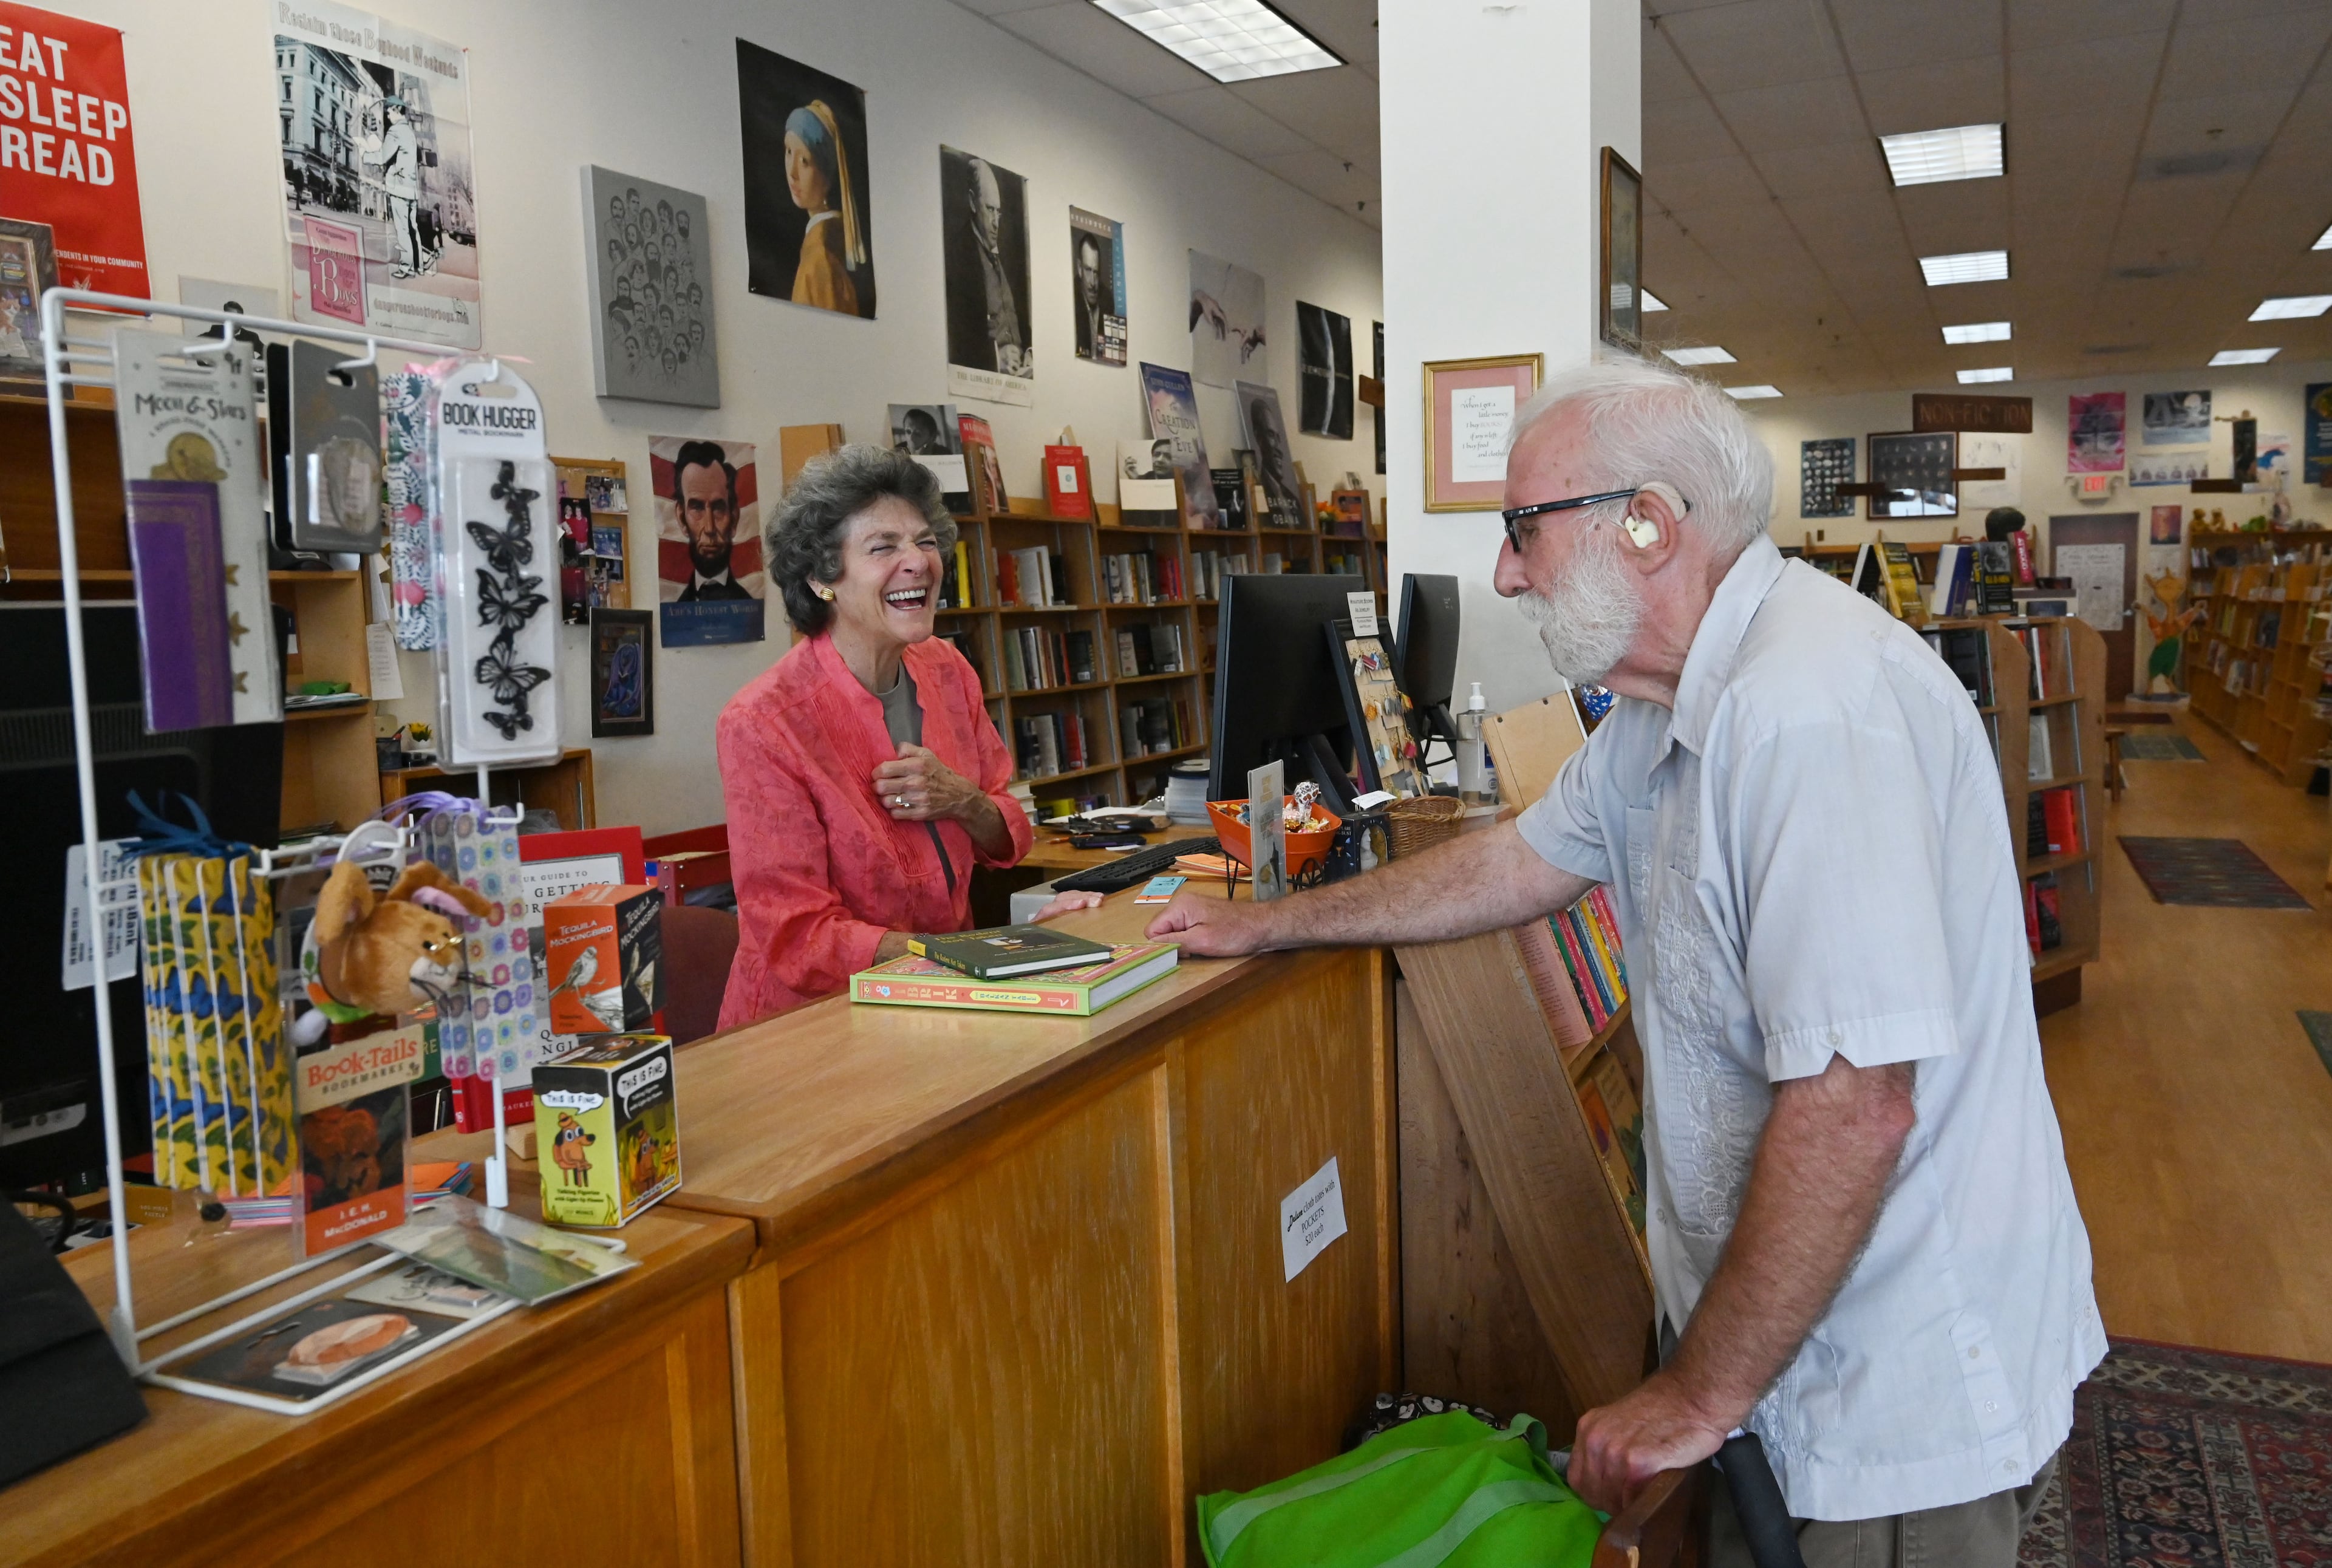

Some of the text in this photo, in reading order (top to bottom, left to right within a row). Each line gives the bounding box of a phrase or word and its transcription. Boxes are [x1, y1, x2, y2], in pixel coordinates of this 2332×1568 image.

[279, 2, 326, 35] Reclaim
[330, 22, 361, 46] those
[0, 24, 67, 81] EAT
[0, 74, 127, 141] SLEEP
[1, 124, 114, 186] READ
[54, 250, 81, 261] ENDENTS
[90, 255, 106, 264] YOUR
[107, 257, 143, 269] COMMUNITY
[443, 403, 536, 429] BOOK HUGGER
[540, 871, 570, 881] GUIDE
[550, 925, 613, 948] MOCKINGBIRD
[559, 919, 598, 936] TEQUILA
[940, 953, 950, 965] Rodent
[894, 986, 957, 1001] IBRIK
[307, 1037, 418, 1088] Book-Tails
[322, 1063, 404, 1094] BOOKMARKS
[622, 1074, 637, 1089] THIS
[639, 1070, 646, 1082] IS
[548, 1094, 564, 1103] THIS
[1287, 1209, 1304, 1232] Deluxe
[1325, 1179, 1335, 1194] with
[1301, 1205, 1325, 1233] POCKETS
[1305, 1222, 1325, 1247] $20 each
